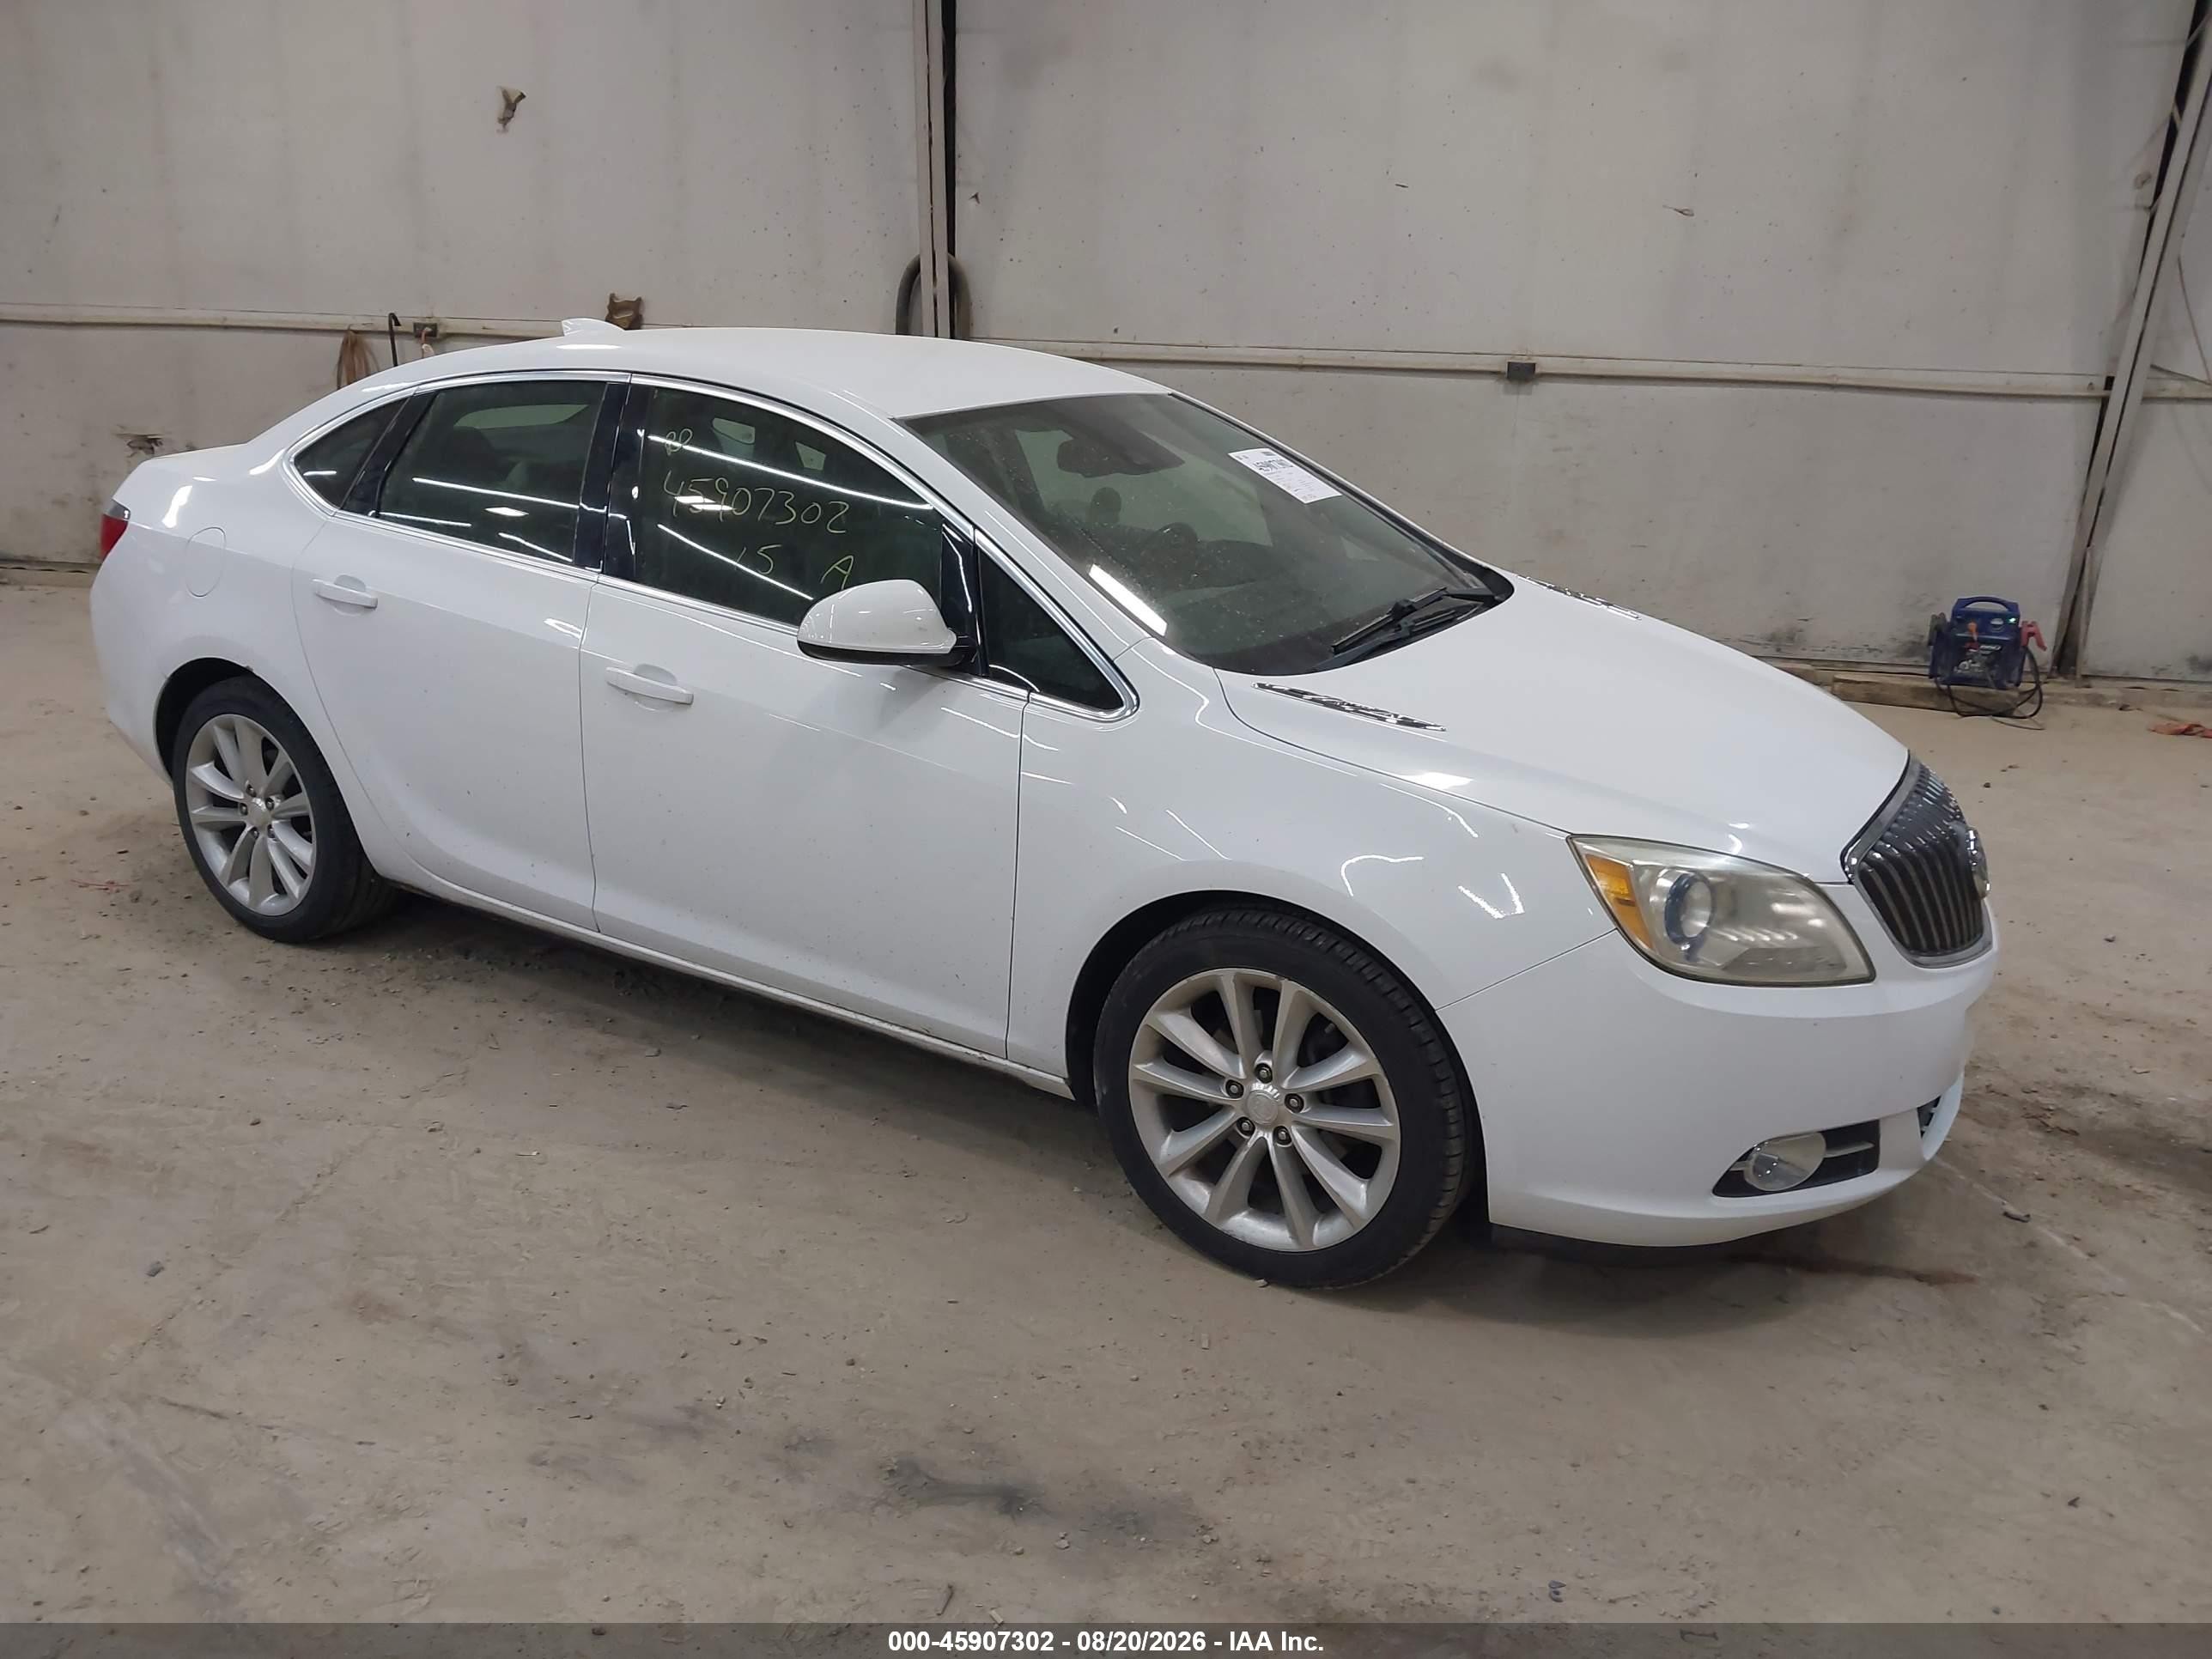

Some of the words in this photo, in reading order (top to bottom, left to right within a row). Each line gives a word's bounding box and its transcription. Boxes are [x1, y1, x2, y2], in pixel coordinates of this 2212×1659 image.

[663, 470, 849, 533] 45907302
[734, 544, 782, 574] 15
[820, 555, 854, 589] A
